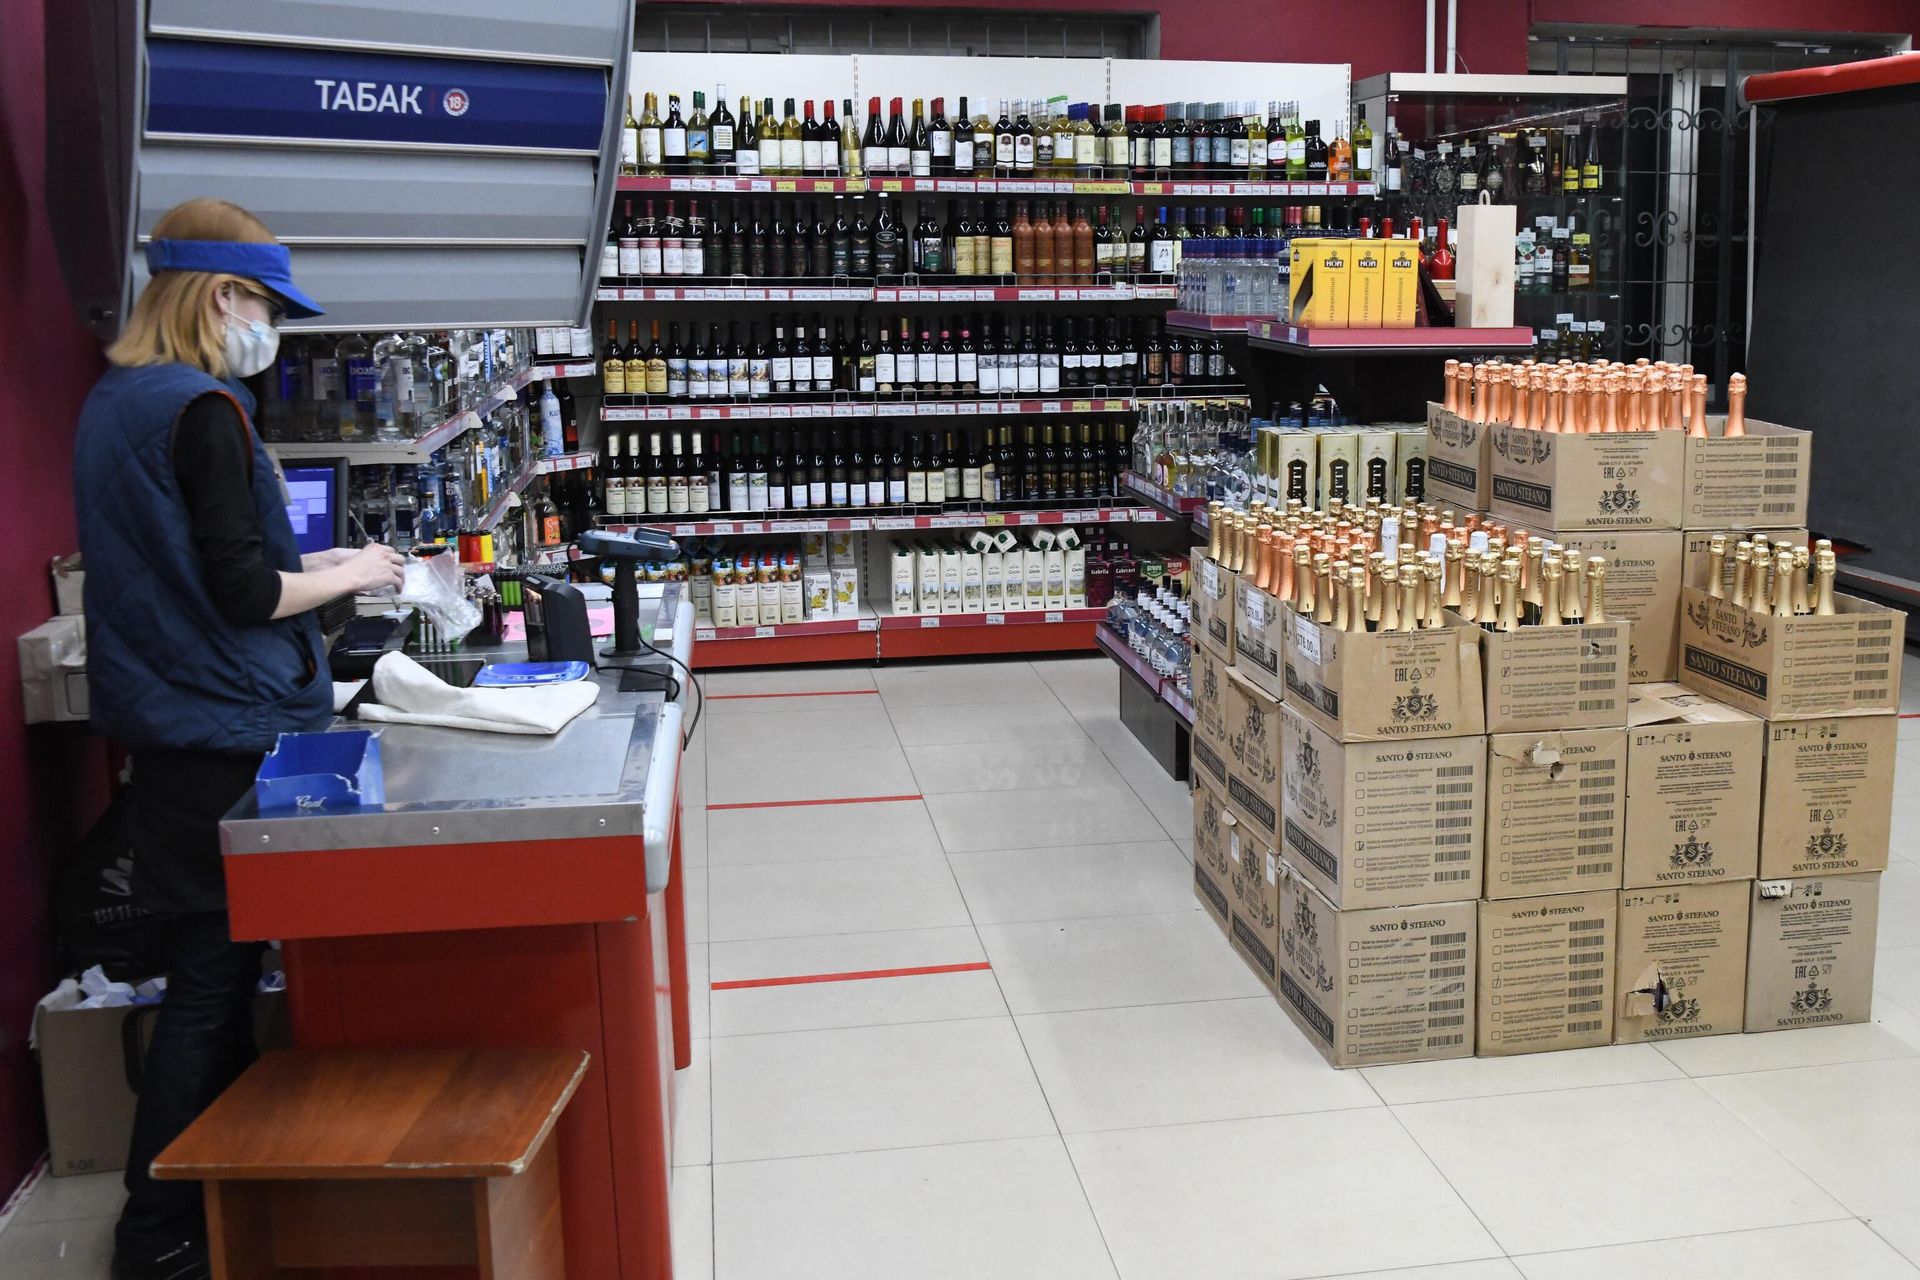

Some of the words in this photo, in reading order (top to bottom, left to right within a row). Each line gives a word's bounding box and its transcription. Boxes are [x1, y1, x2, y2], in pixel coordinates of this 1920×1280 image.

[314, 79, 422, 114] ТАБАК
[1431, 462, 1447, 476] SANTO
[1448, 466, 1472, 486] STEFANO
[1497, 481, 1517, 498] SANTO
[1518, 486, 1547, 505] STEFANO
[1586, 517, 1614, 526] SANTO
[1616, 516, 1652, 525] STEFANO
[1716, 609, 1737, 625] SANTO
[1711, 619, 1740, 638] STEFANO
[1297, 632, 1313, 654] 276.00
[1395, 668, 1408, 682] EAC
[1690, 652, 1719, 673] SANTO
[1721, 665, 1760, 690] STEFANO
[1377, 725, 1408, 734] SANTO
[1411, 723, 1452, 733] STEFANO
[1562, 745, 1596, 755] TEFANO
[1798, 744, 1823, 752] SANTO
[1833, 742, 1867, 751] STEFANO
[1376, 753, 1404, 762] SANTO
[1415, 751, 1452, 760] STEFANO
[1660, 753, 1686, 762] SANTO
[1697, 751, 1731, 760] STEFANO
[1231, 780, 1249, 807] SANTO
[1251, 799, 1273, 825] STEFANO
[1287, 825, 1306, 854] SANTO
[1305, 840, 1333, 873] STEFANO
[1792, 862, 1820, 871] SANTO
[1822, 860, 1858, 870] STEFANO
[1656, 871, 1685, 881] SANTO
[1687, 868, 1725, 879] STEFANO
[1783, 903, 1808, 911] SANTO
[1818, 899, 1851, 908] STEFANO
[1511, 911, 1538, 919] SANTO
[1549, 906, 1584, 915] STEFANO
[1648, 913, 1674, 922] SANTO
[1684, 911, 1719, 919] STEFANO
[1370, 923, 1398, 932] SANTO
[1409, 920, 1445, 929] STEFANO
[1283, 976, 1302, 1008] SANTO
[1303, 996, 1330, 1036] STEFANO
[1777, 1016, 1805, 1026] SANTO
[1806, 1013, 1843, 1024] STEFANO
[1644, 1027, 1672, 1037] SANTO
[1674, 1024, 1712, 1034] STEFANO
